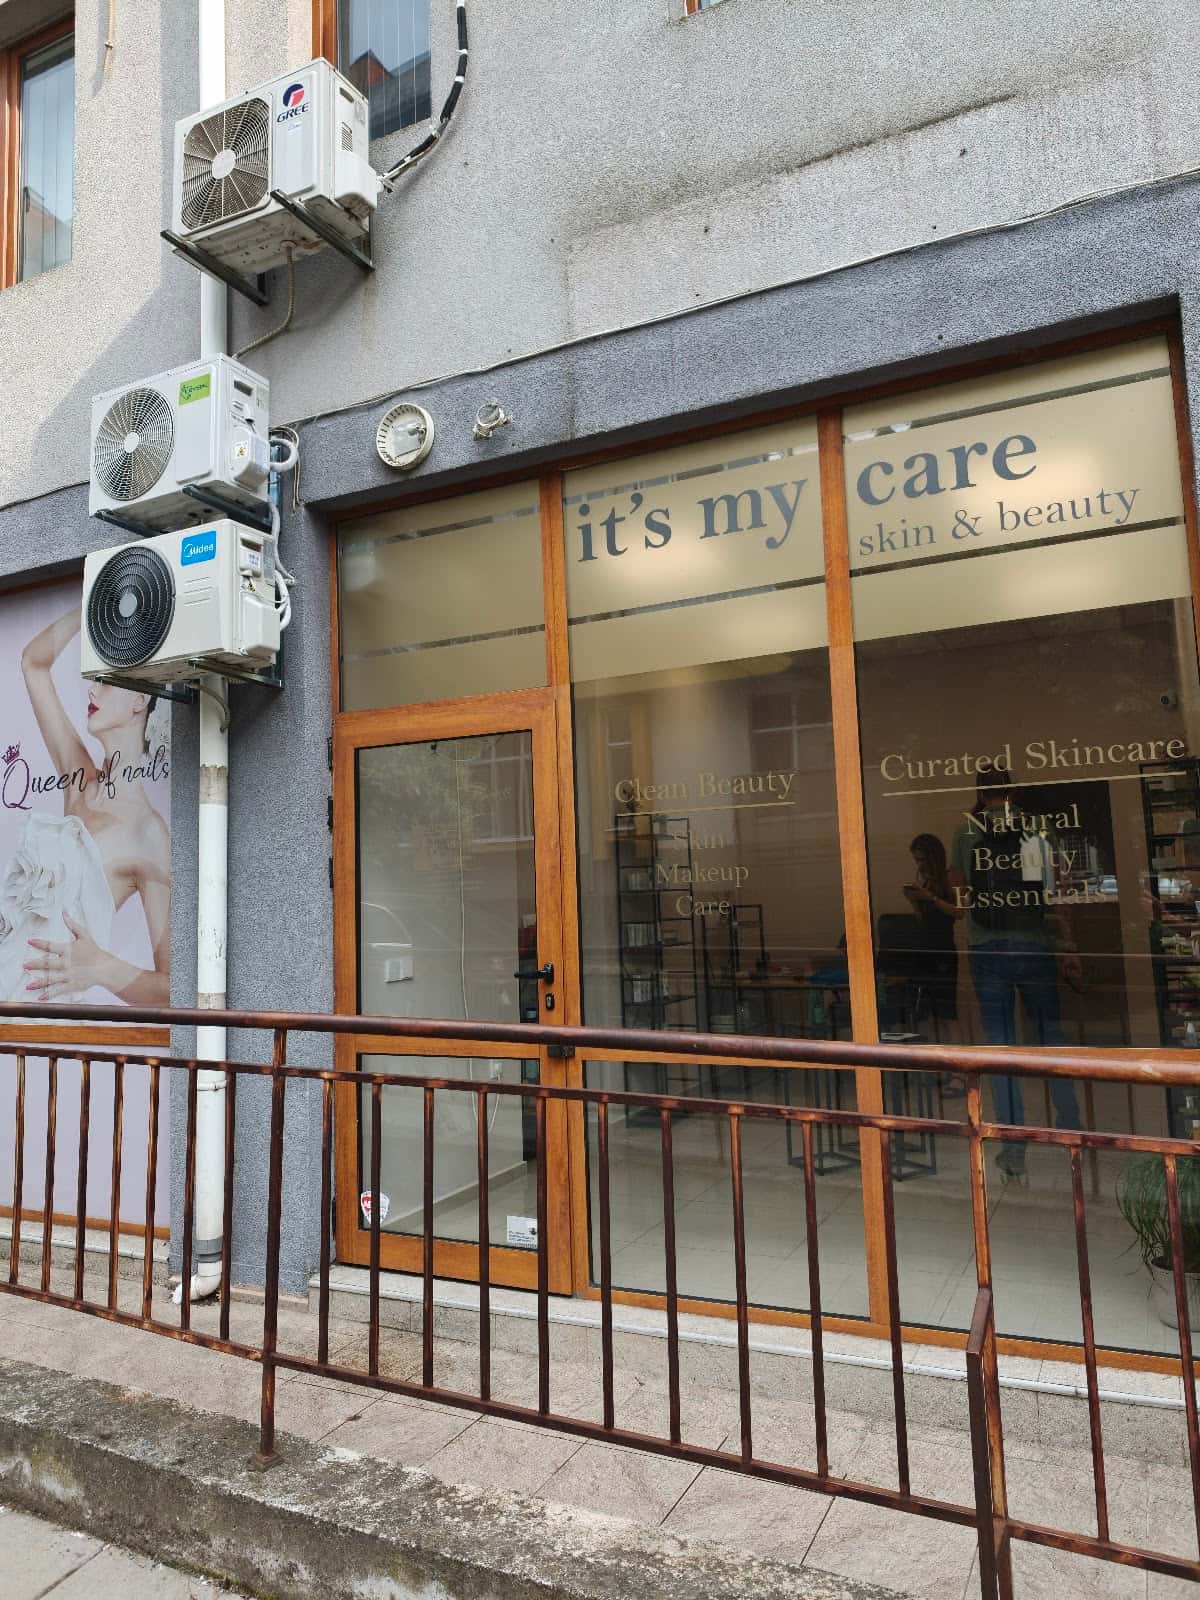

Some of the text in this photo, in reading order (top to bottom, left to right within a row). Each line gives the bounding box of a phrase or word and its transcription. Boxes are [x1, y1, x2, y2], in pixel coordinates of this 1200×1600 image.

[276, 102, 311, 123] GREE
[696, 479, 808, 550] my
[856, 433, 1037, 506] care
[859, 487, 1140, 556] skin & beauty
[184, 543, 214, 558] Midea
[880, 737, 1186, 782] Curated Skincare
[2, 744, 169, 810] Queen of nails
[615, 770, 796, 803] Clean Beauty
[962, 803, 1081, 836] Natural
[655, 862, 749, 888] Makeup
[974, 847, 1078, 875] Beauty
[675, 895, 730, 917] Care
[951, 879, 1108, 910] Essentials
